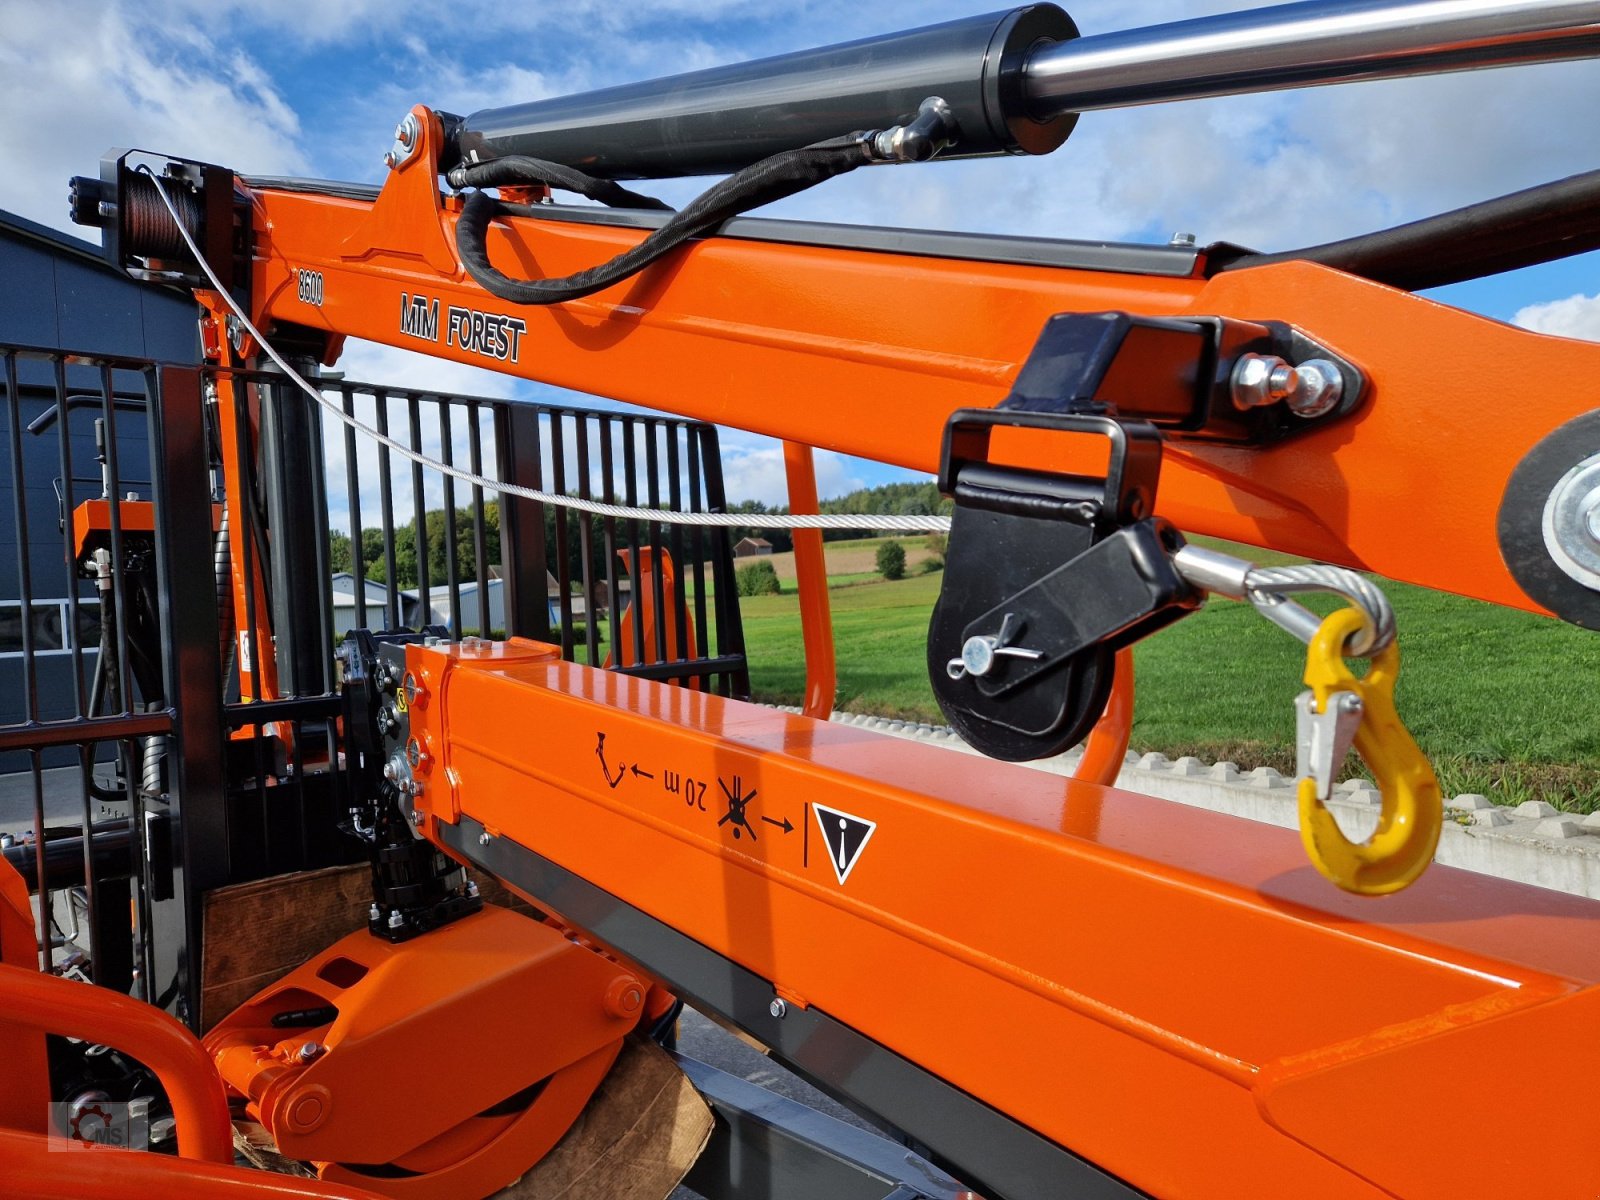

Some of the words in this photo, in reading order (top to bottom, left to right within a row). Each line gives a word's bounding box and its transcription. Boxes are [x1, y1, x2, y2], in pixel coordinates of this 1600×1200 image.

[298, 269, 324, 307] 8600
[400, 292, 440, 342] MTM
[446, 305, 528, 363] FOREST
[664, 769, 680, 795] m
[685, 778, 707, 812] 20
